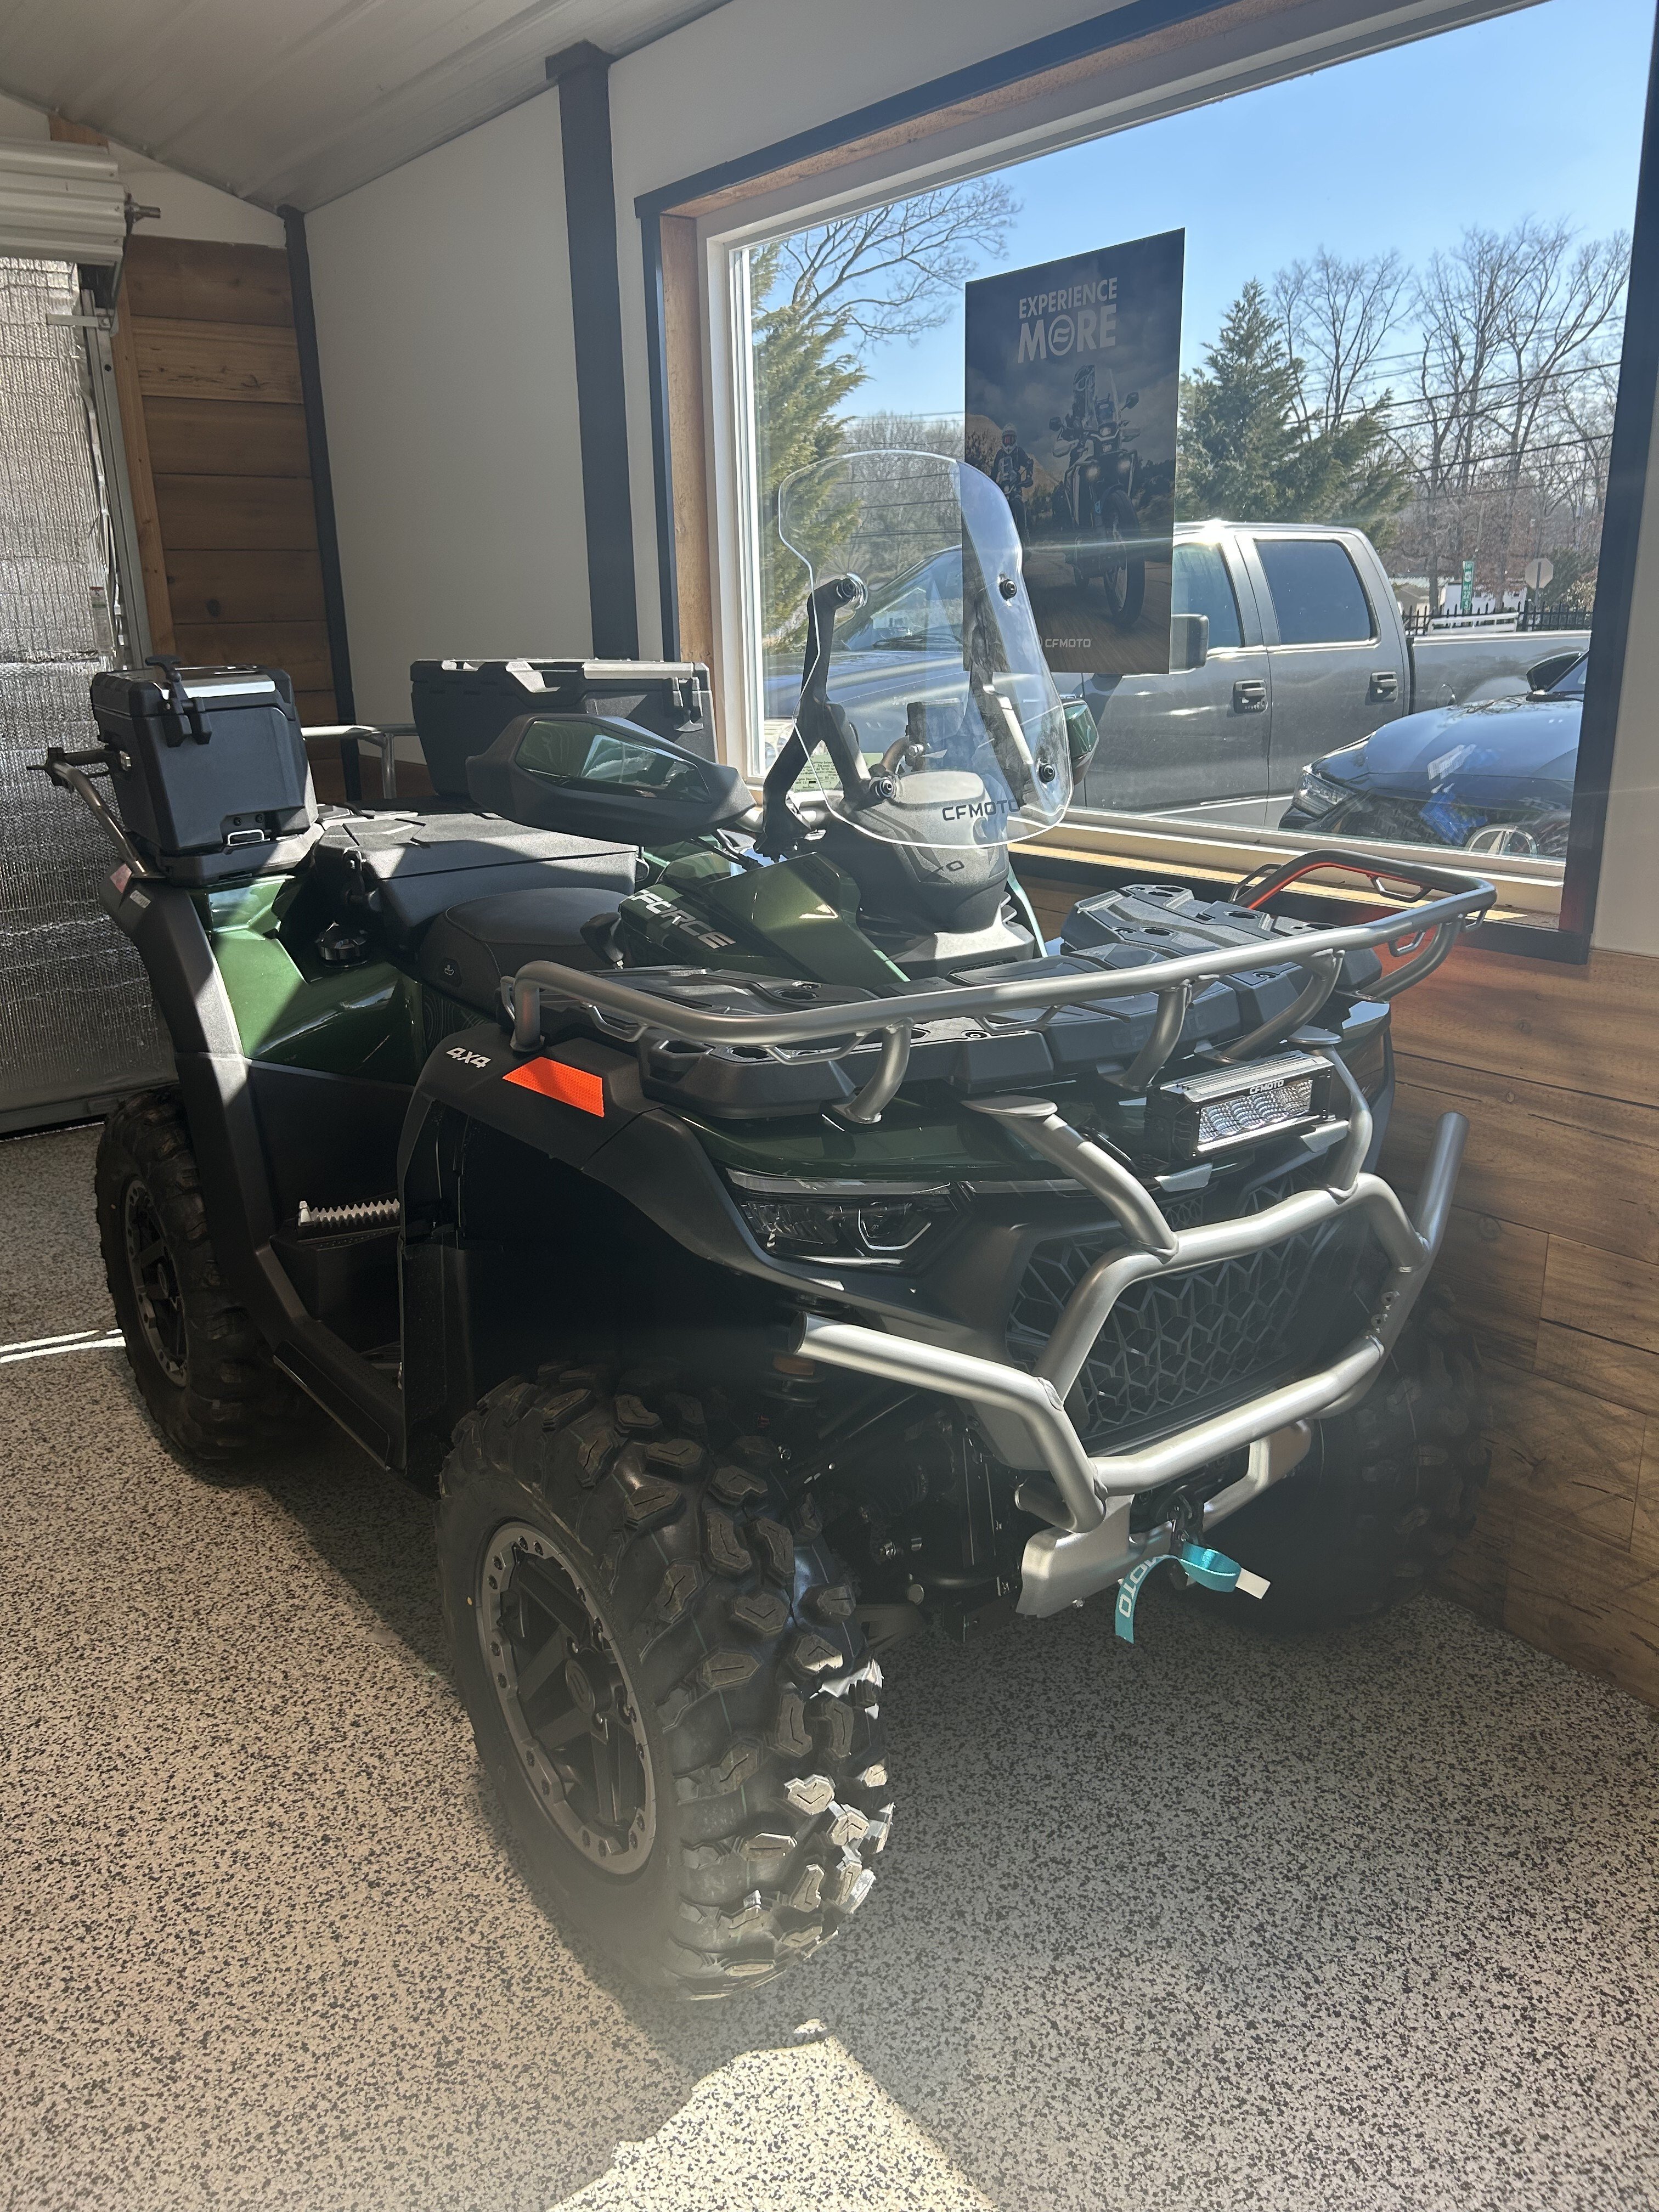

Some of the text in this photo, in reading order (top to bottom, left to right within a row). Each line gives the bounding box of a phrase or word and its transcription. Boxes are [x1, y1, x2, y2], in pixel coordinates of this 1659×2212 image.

[1019, 277, 1118, 319] EXPERIENCE
[1018, 303, 1117, 364] MORE
[1045, 638, 1091, 648] CFMOTO
[942, 799, 1020, 821] CFMOTO
[1249, 1079, 1284, 1094] CFMOTO
